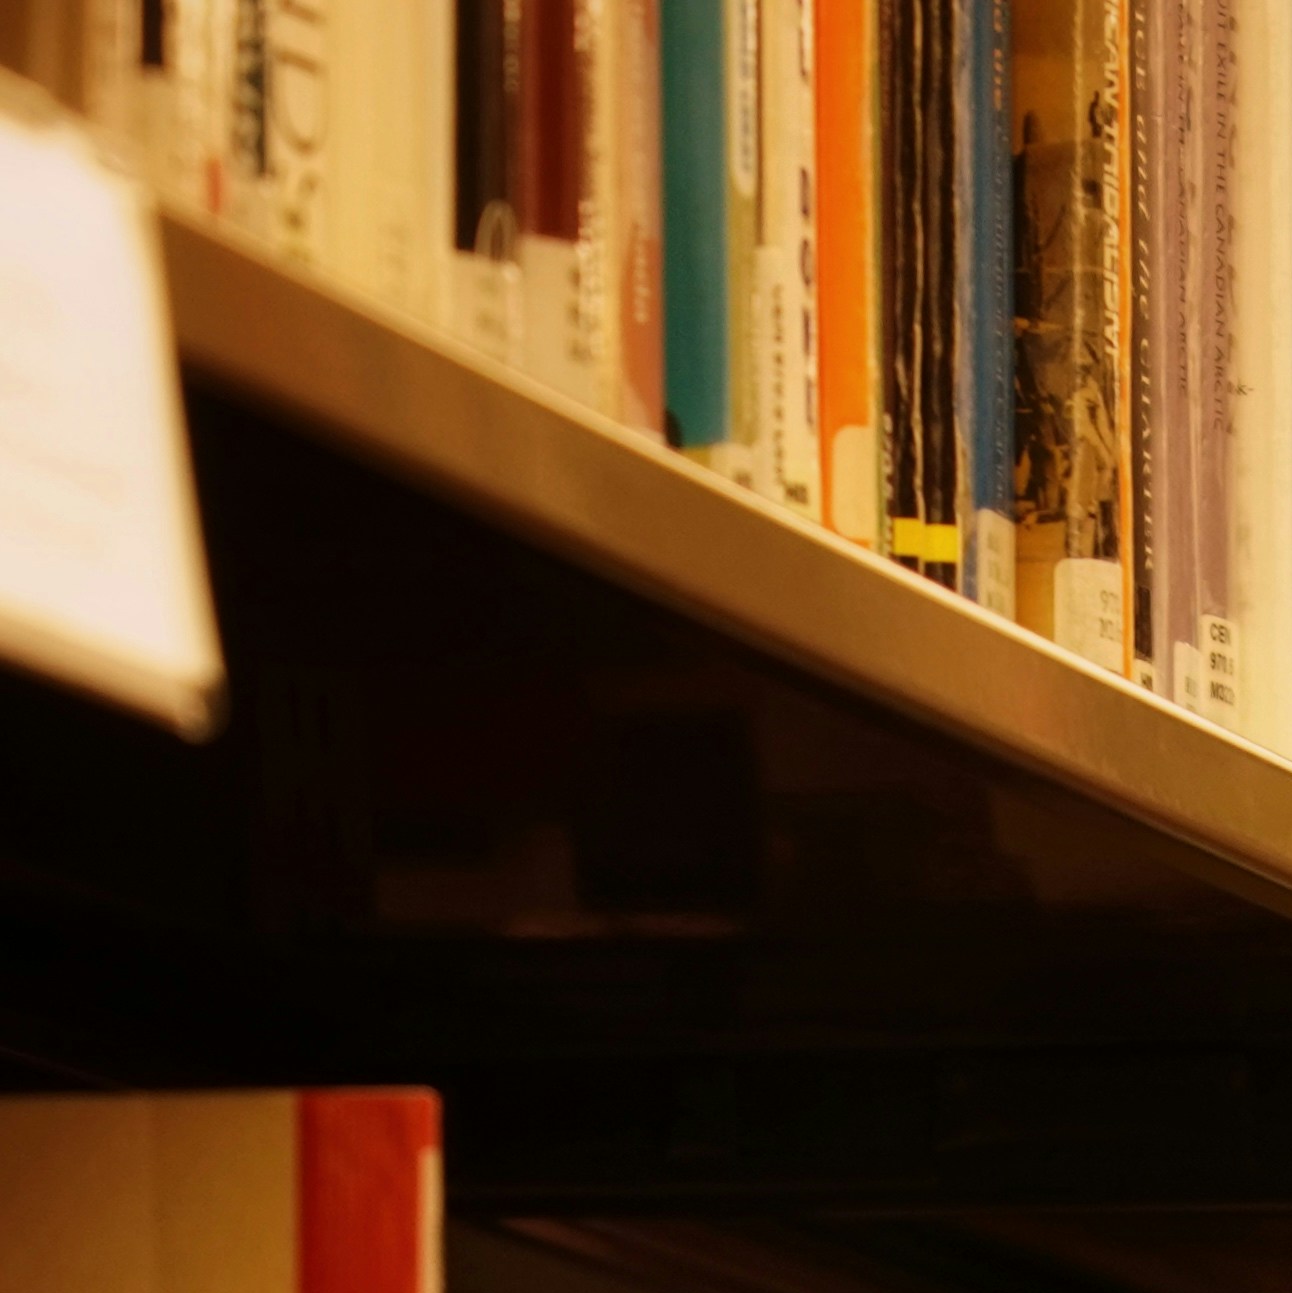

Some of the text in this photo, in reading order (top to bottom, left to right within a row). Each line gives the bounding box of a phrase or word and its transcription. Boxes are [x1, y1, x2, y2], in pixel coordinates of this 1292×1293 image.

[1216, 43, 1227, 102] EXILE
[1216, 113, 1226, 139] IN
[1216, 152, 1226, 193] THE
[1137, 238, 1152, 318] the
[1215, 204, 1226, 336] CANADIAN
[1213, 345, 1225, 431] ARCTIC
[1138, 338, 1155, 569] CHARTER
